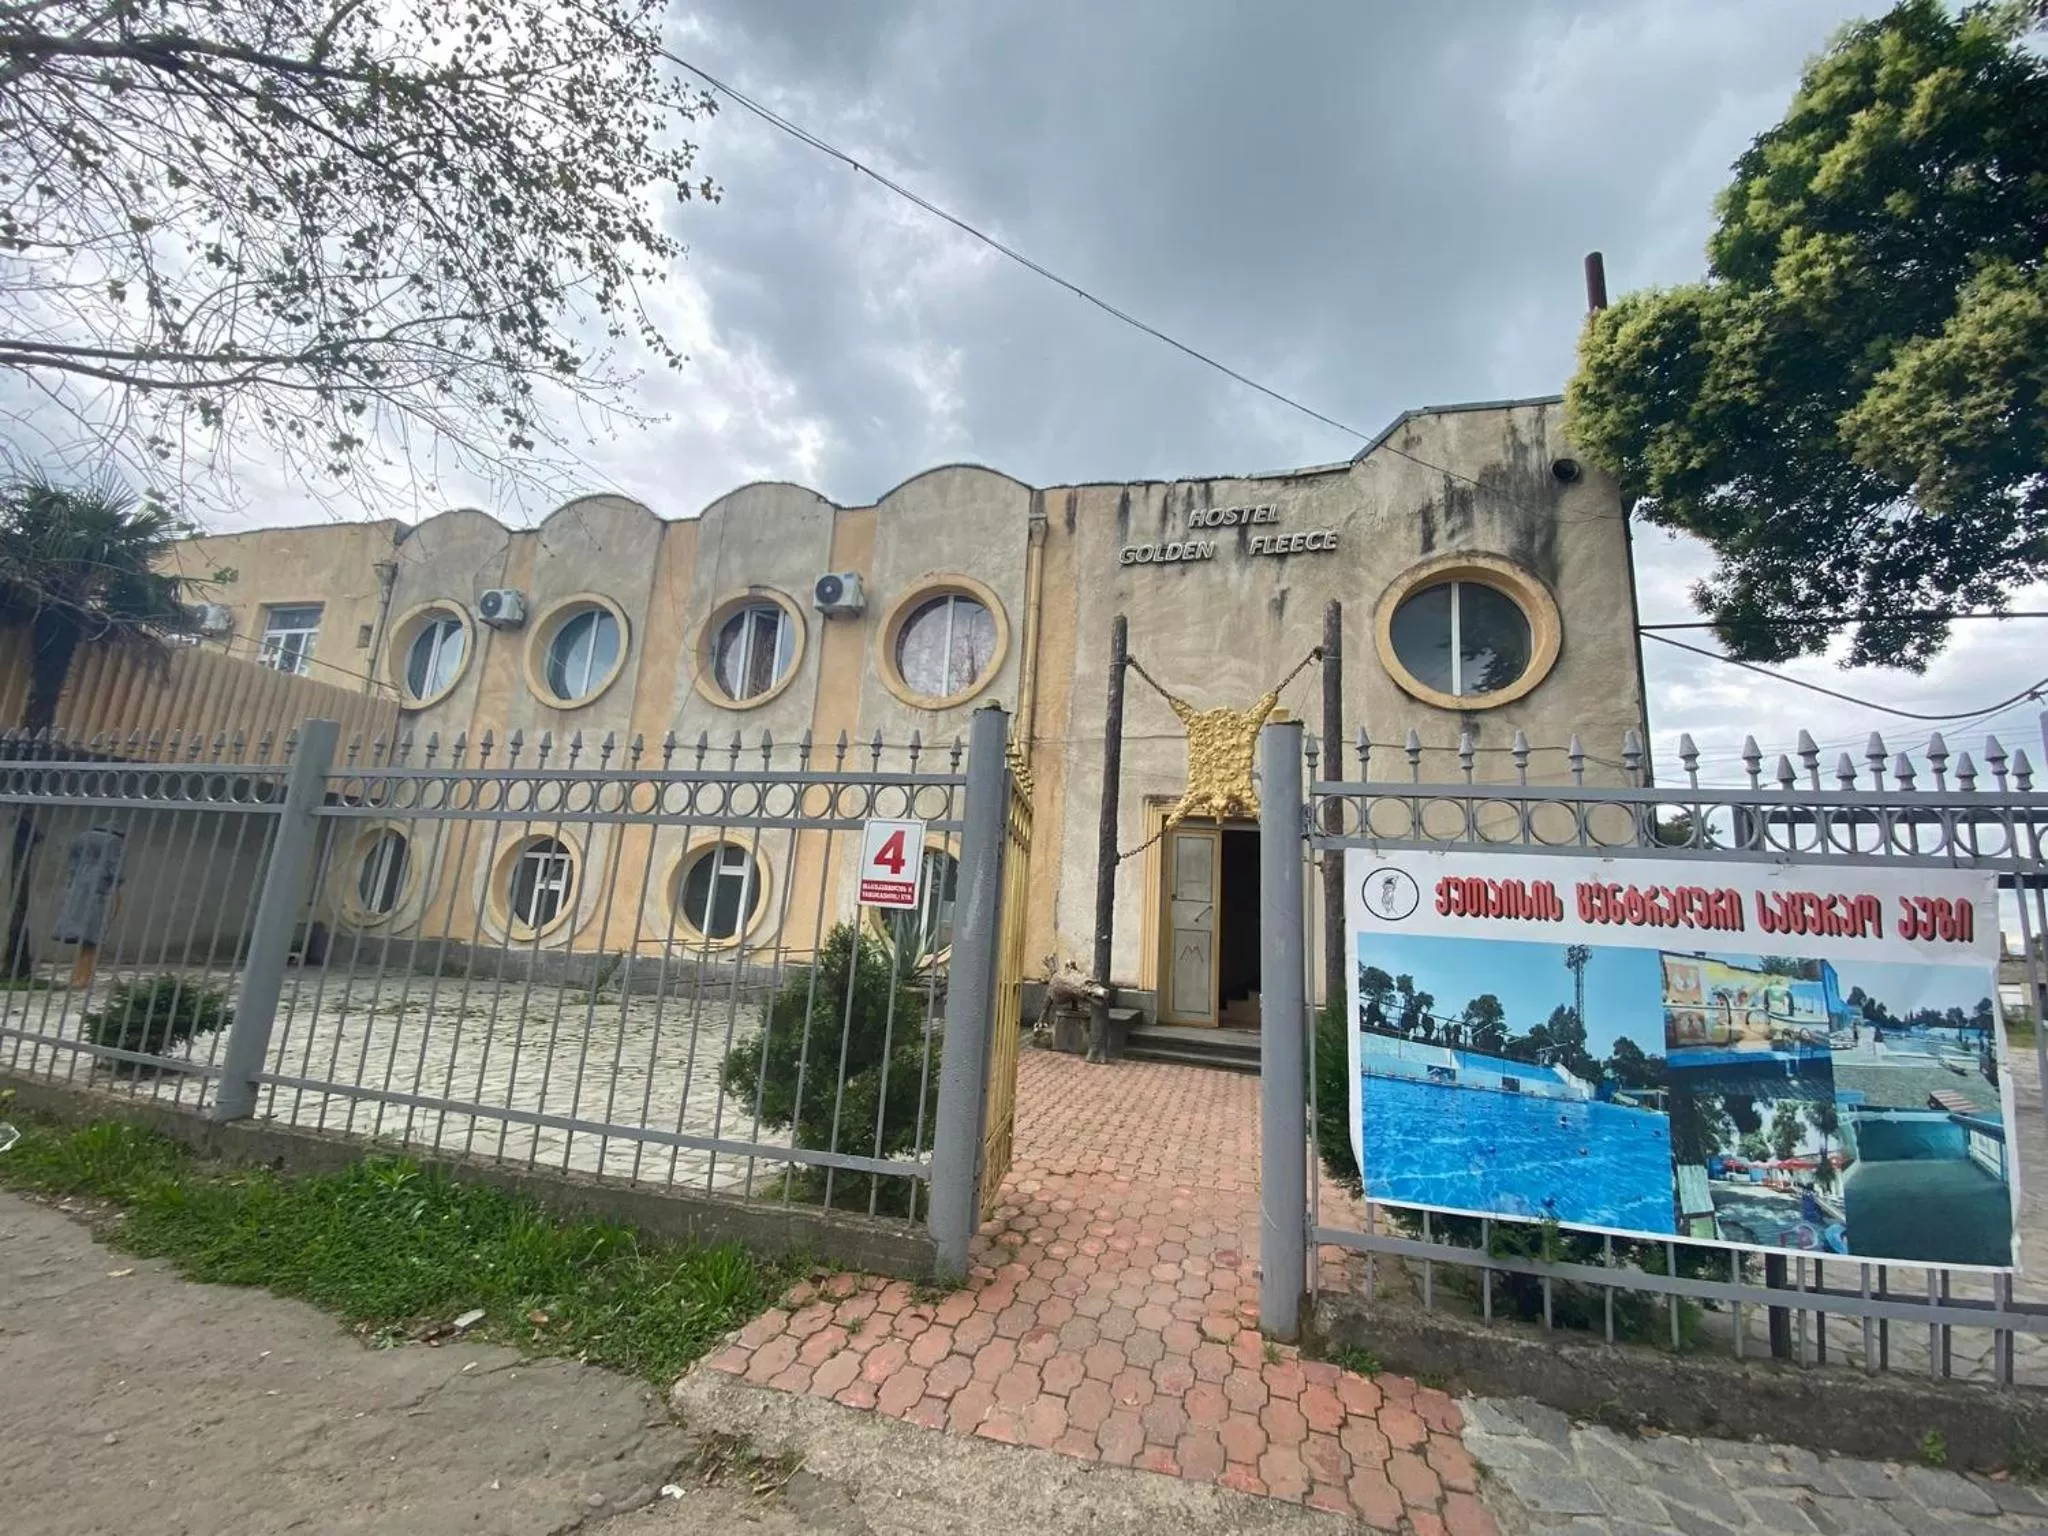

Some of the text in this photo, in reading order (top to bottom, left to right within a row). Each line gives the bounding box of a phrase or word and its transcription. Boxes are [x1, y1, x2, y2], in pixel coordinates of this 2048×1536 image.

[1188, 504, 1280, 529] HOSTEL
[1119, 530, 1338, 566] GOLDEN FLEECE
[873, 830, 906, 875] 4
[1435, 876, 1974, 943] ქუთაისის ცენტრალური საცურაო აუზი
